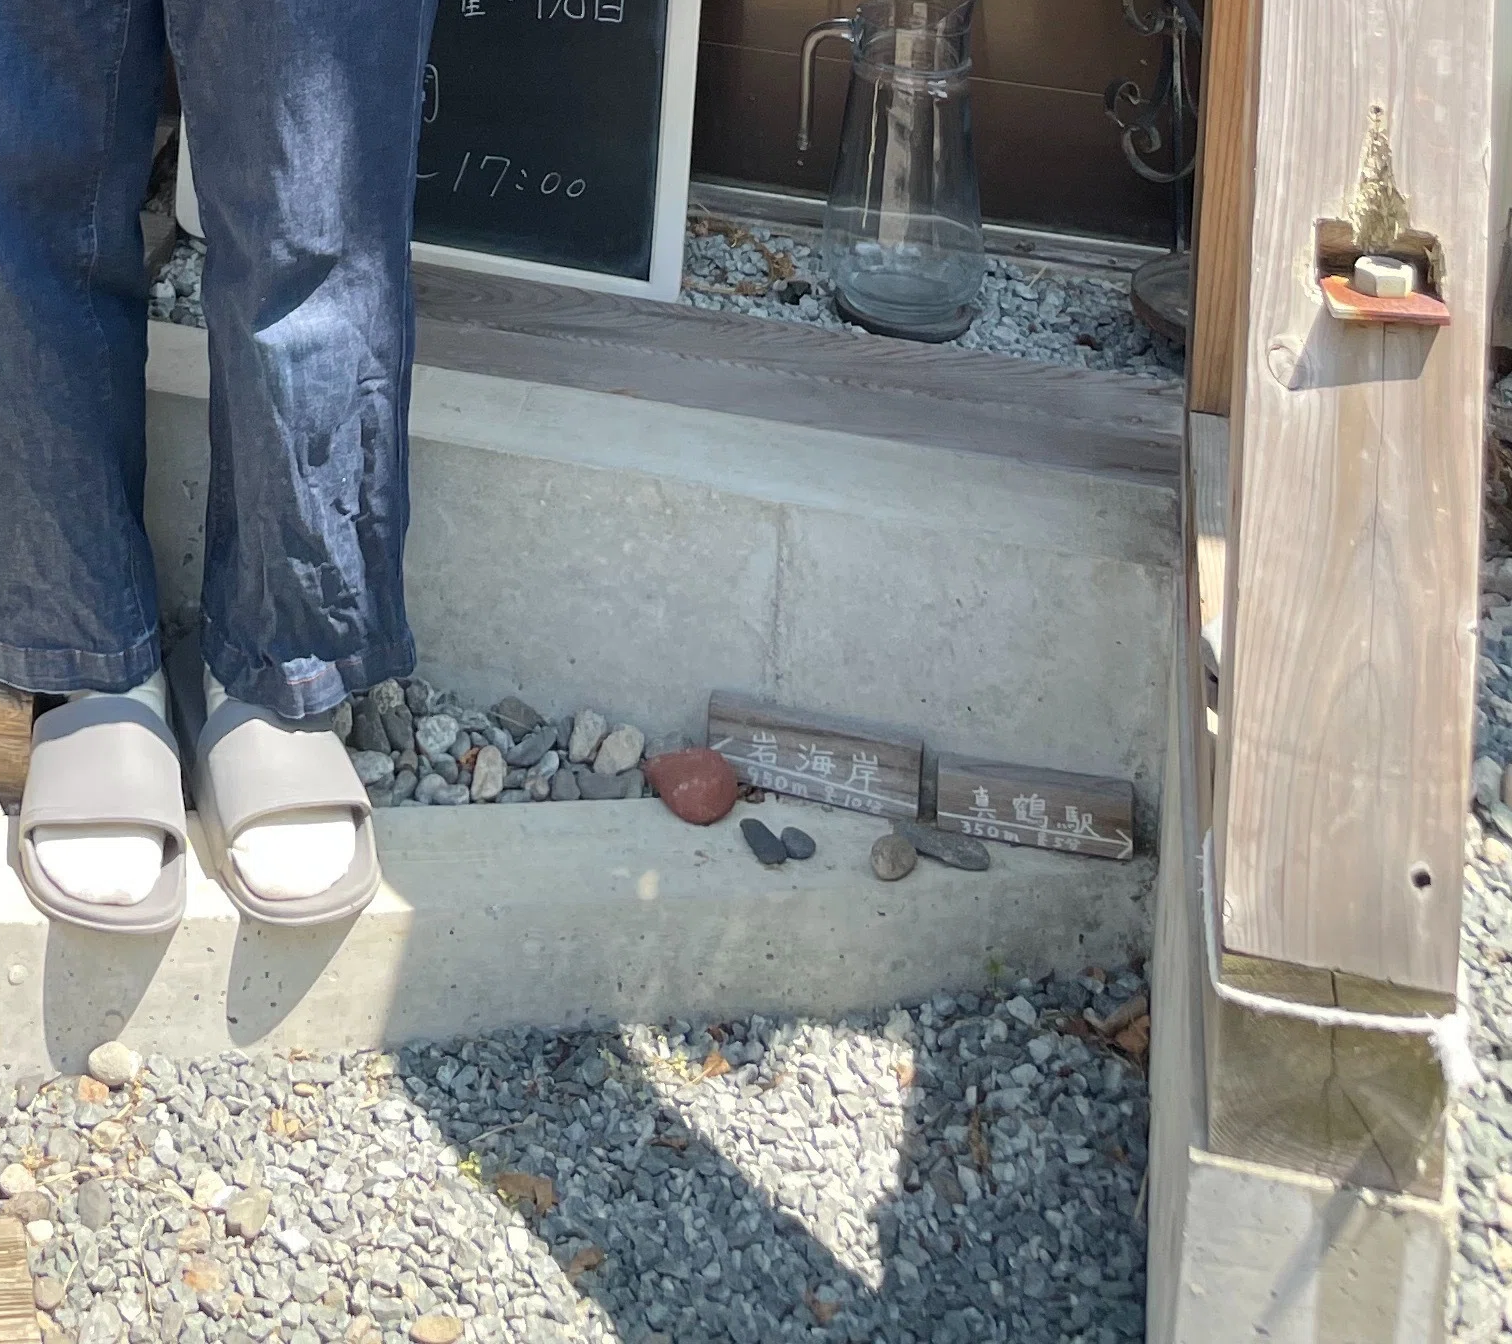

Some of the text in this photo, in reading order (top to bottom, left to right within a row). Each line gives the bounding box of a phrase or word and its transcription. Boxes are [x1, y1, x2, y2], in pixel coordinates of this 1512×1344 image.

[747, 731, 883, 793] 岩海岸
[969, 785, 1102, 838] 真鶴駅
